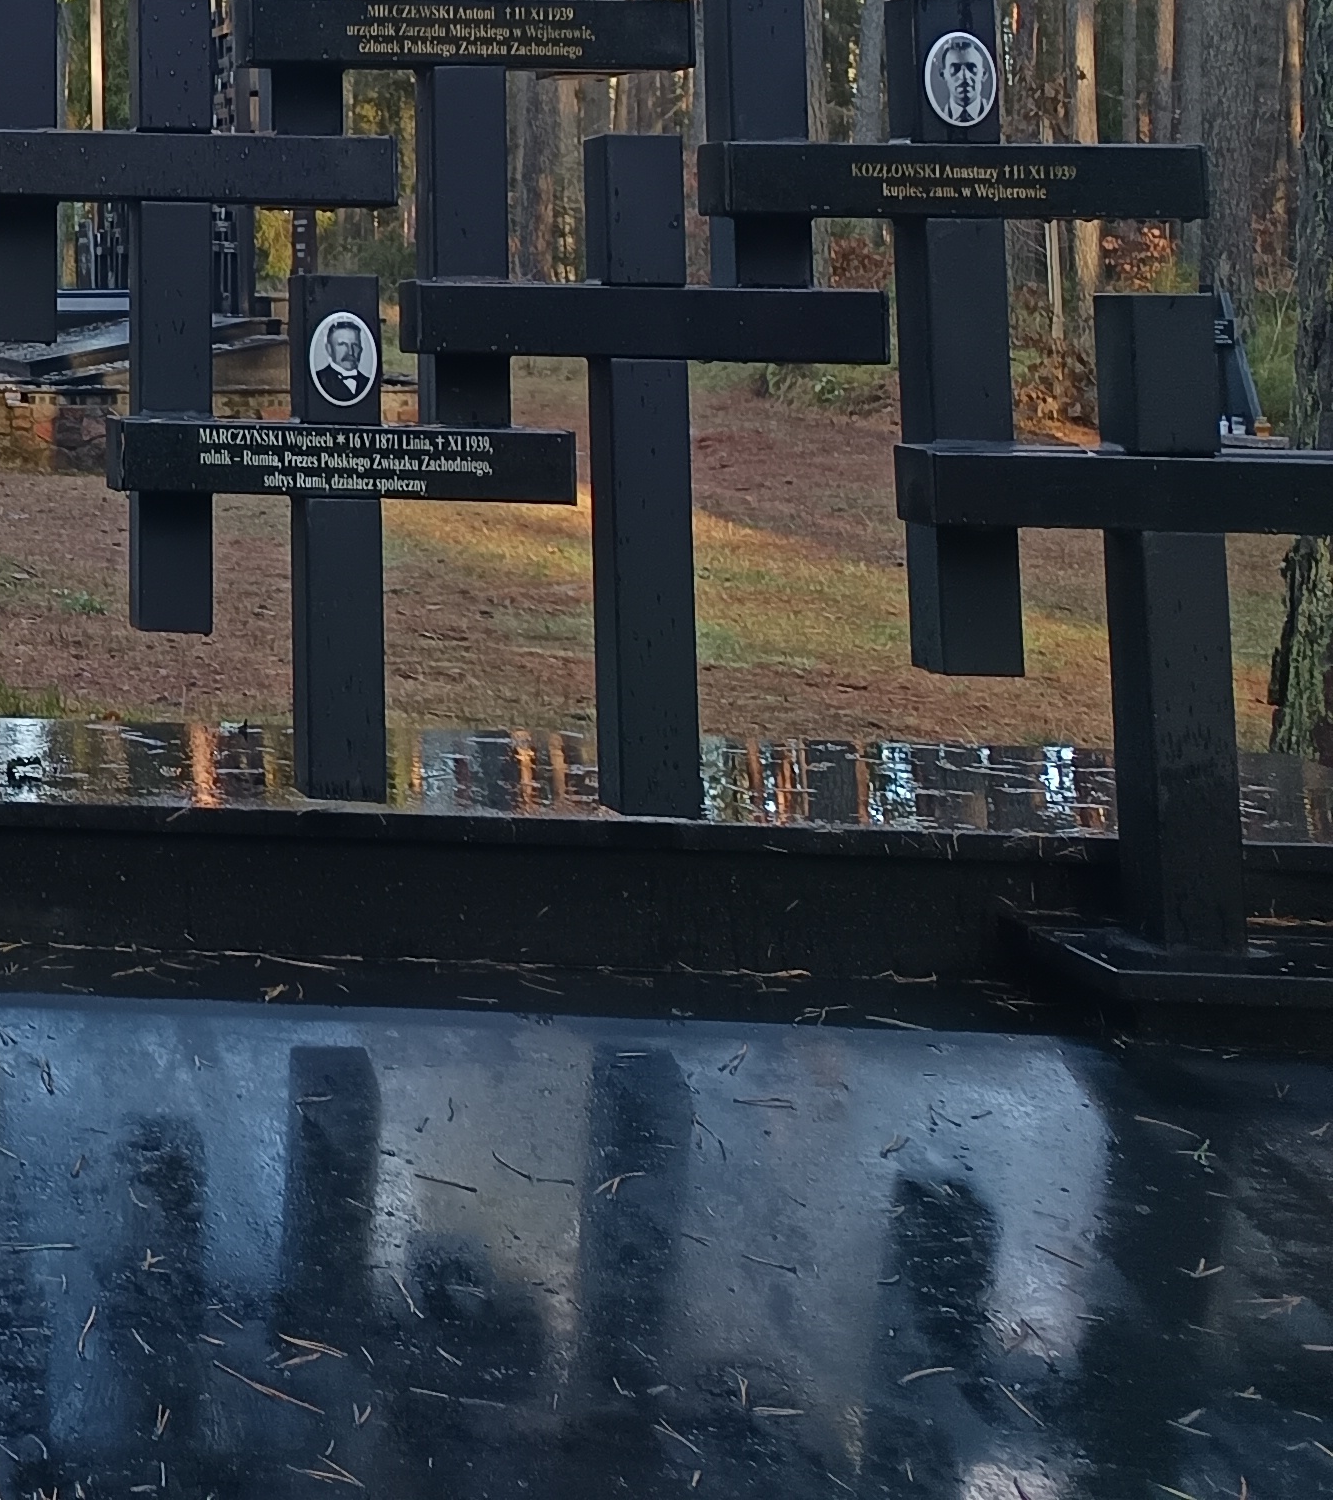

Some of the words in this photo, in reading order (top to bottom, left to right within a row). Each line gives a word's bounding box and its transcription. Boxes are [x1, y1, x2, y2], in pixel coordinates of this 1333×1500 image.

[367, 5, 453, 20] MILCZEWSKI
[457, 6, 495, 20] Antoni
[548, 7, 574, 21] 1939
[346, 23, 395, 39] urzędnik
[399, 23, 445, 40] Zarządu
[449, 24, 509, 40] Miejskiego
[525, 25, 596, 42] Wejherowie,
[404, 40, 456, 57] Polskiego
[459, 41, 507, 57] Związku
[510, 42, 582, 59] Zachodniego
[852, 163, 940, 179] KOZŁOWSKI
[943, 164, 998, 183] Anastazy
[1029, 165, 1044, 179] XI
[1049, 166, 1076, 180] 1939
[883, 182, 926, 200] kupiec,
[929, 187, 958, 198] zam.
[975, 184, 1046, 201] Wejherowie
[199, 427, 282, 445] MARCZYŃSKI
[285, 431, 333, 450] Wojciech
[375, 434, 398, 449] 1871
[402, 434, 433, 453] Linia,
[447, 435, 461, 451] XI
[465, 436, 493, 455] 1939,
[200, 449, 232, 465] rolnik
[243, 450, 282, 469] Rumia,
[285, 452, 318, 467] Prezes
[321, 453, 370, 473] Polskiego
[373, 454, 419, 474] Związku
[421, 455, 493, 477] Zachodniego,
[296, 472, 329, 493] Rumi,
[331, 473, 374, 489] działacz
[376, 475, 427, 495] społeczny
